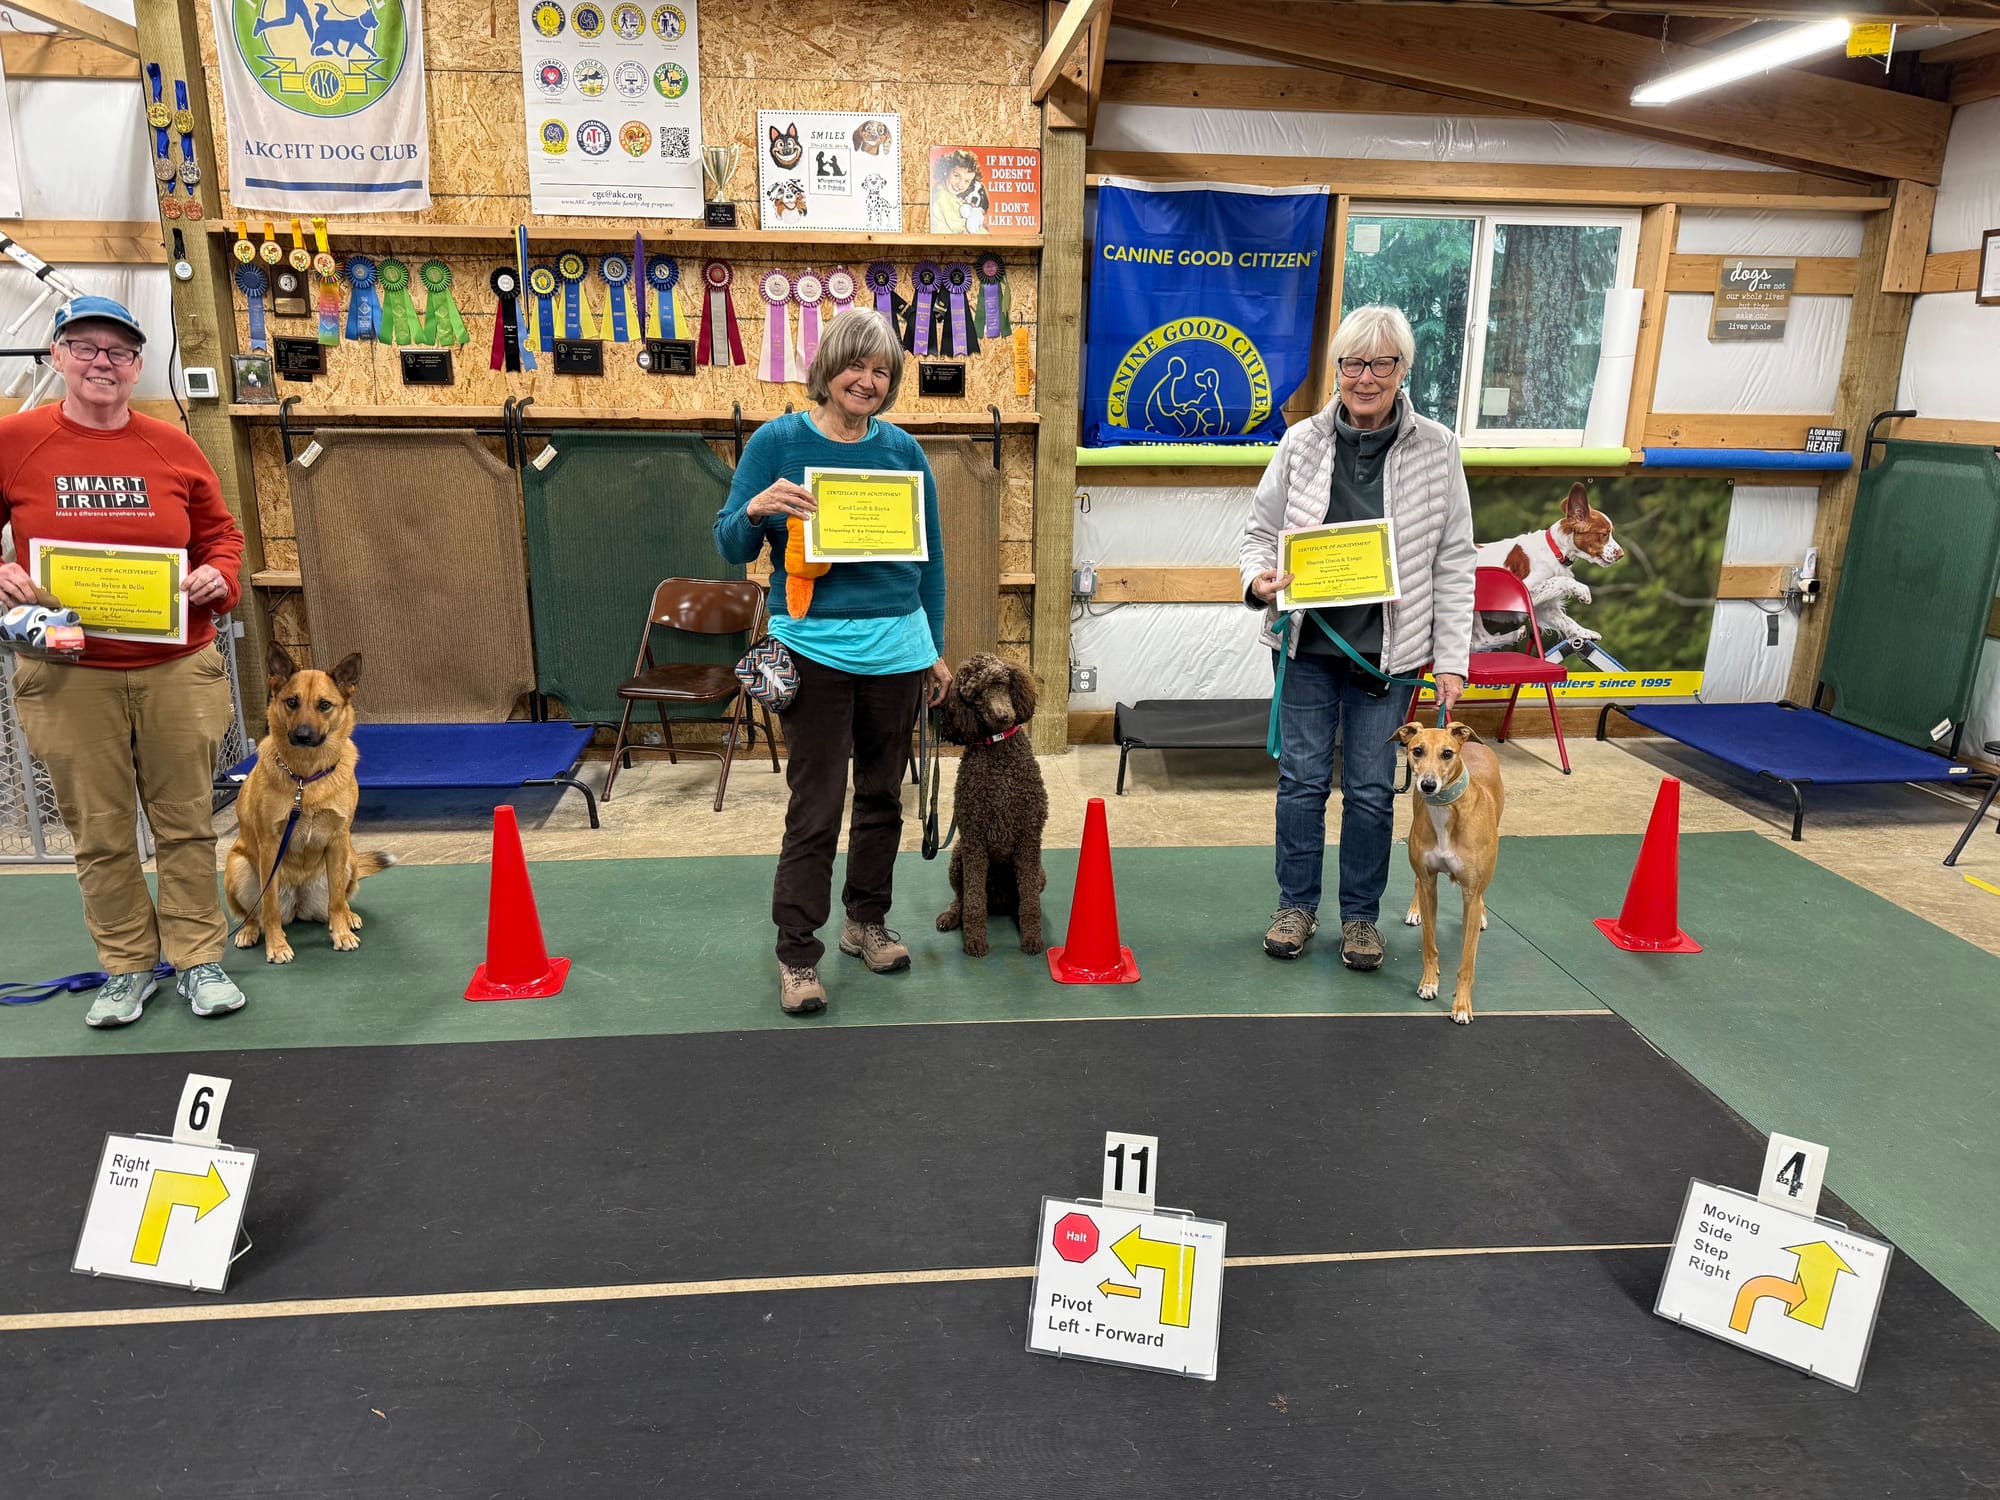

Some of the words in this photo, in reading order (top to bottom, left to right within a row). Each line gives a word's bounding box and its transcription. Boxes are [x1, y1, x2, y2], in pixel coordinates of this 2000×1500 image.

[312, 70, 338, 98] AKC
[810, 131, 846, 140] SMILES
[245, 140, 282, 159] AKC
[285, 144, 314, 160] FIT
[320, 144, 365, 160] DOG
[370, 144, 418, 160] CLUB
[986, 155, 997, 166] IF
[998, 156, 1014, 166] MY
[1016, 156, 1037, 166] DOG
[992, 169, 1032, 179] DOESN'T
[592, 190, 642, 200] cgc@akc.org
[988, 182, 1013, 192] LIKE
[1015, 182, 1037, 194] YOU,
[994, 202, 998, 212] I
[1001, 202, 1030, 213] DON'T
[988, 216, 1013, 226] LIKE
[1015, 216, 1037, 226] YOU.
[1103, 244, 1174, 264] CANINE
[1178, 250, 1234, 266] GOOD
[1730, 261, 1772, 291] dogs
[1111, 336, 1159, 418] CANINE
[1162, 320, 1228, 342] GOOD
[1231, 337, 1269, 427] CITIZEN
[1807, 441, 1840, 452] HEART
[56, 477, 142, 491] SMART
[58, 493, 145, 508] TRIPS
[1598, 679, 1636, 688] since
[1641, 678, 1672, 687] 1995
[188, 1086, 214, 1130] 6
[112, 1154, 150, 1173] Right
[1107, 1143, 1149, 1194] 11
[108, 1172, 138, 1188] Turn
[1776, 1151, 1806, 1197] 4
[1703, 1203, 1760, 1235] Moving
[1066, 1230, 1087, 1243] Halt
[1698, 1221, 1732, 1242] Side
[1693, 1238, 1728, 1261] Step
[1688, 1255, 1731, 1280] Right
[1050, 1292, 1093, 1313] Pivot
[1048, 1315, 1079, 1333] Left
[1095, 1324, 1164, 1347] Forward
